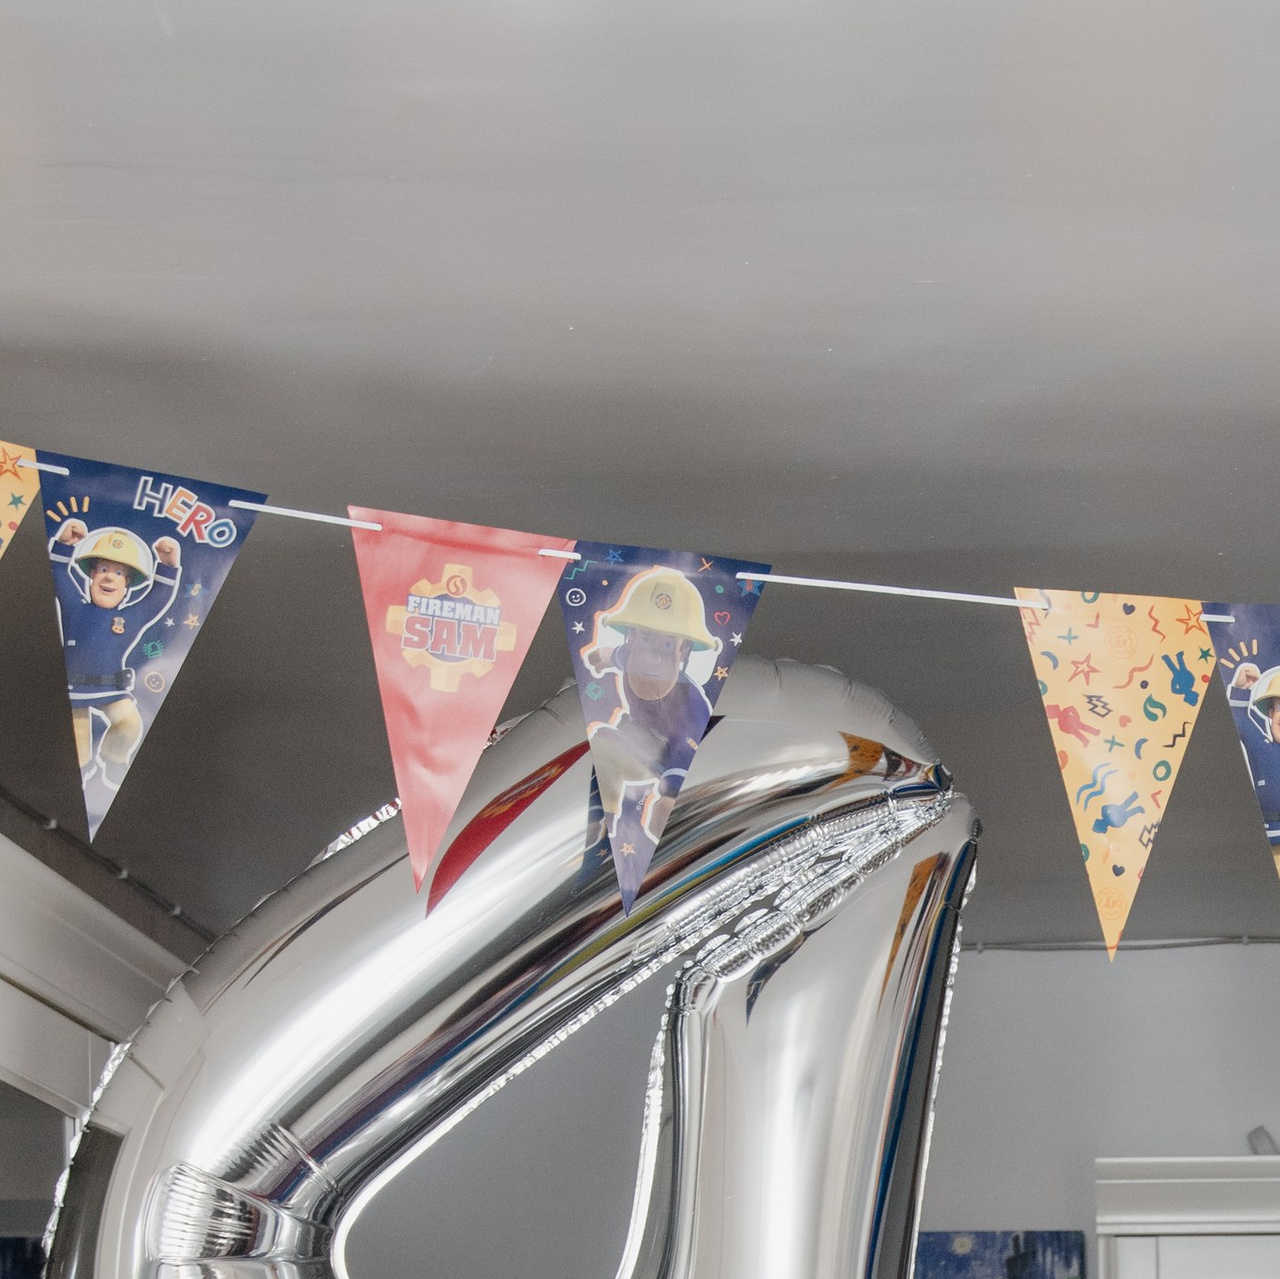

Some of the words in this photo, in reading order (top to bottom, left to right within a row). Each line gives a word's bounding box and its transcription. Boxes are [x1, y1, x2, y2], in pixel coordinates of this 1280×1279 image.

[133, 476, 237, 548] HERO
[407, 595, 501, 626] FIREMAN
[401, 615, 500, 662] SAM
